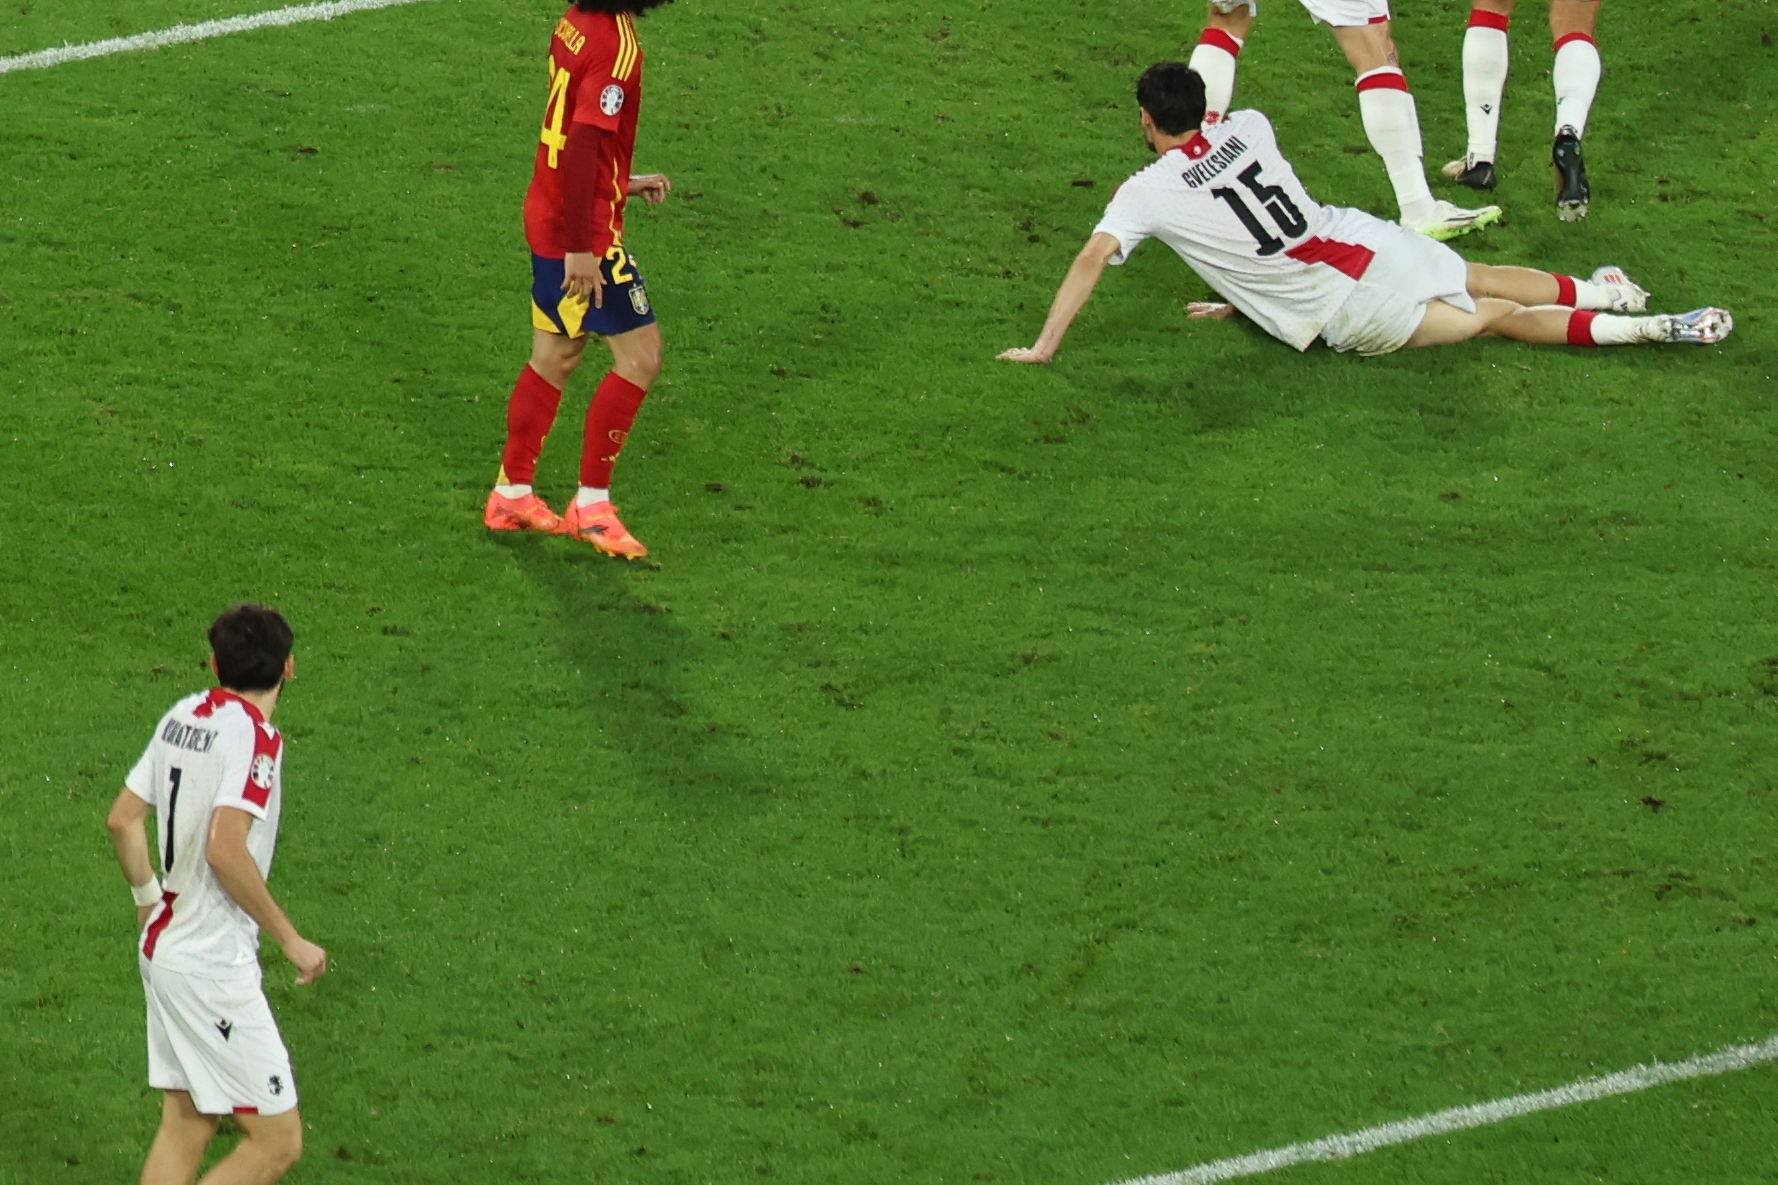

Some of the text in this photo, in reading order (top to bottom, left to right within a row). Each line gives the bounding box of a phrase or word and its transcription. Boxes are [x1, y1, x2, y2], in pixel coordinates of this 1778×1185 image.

[541, 54, 570, 170] 4
[1181, 135, 1249, 189] GVELESIANI
[1210, 159, 1309, 257] 15
